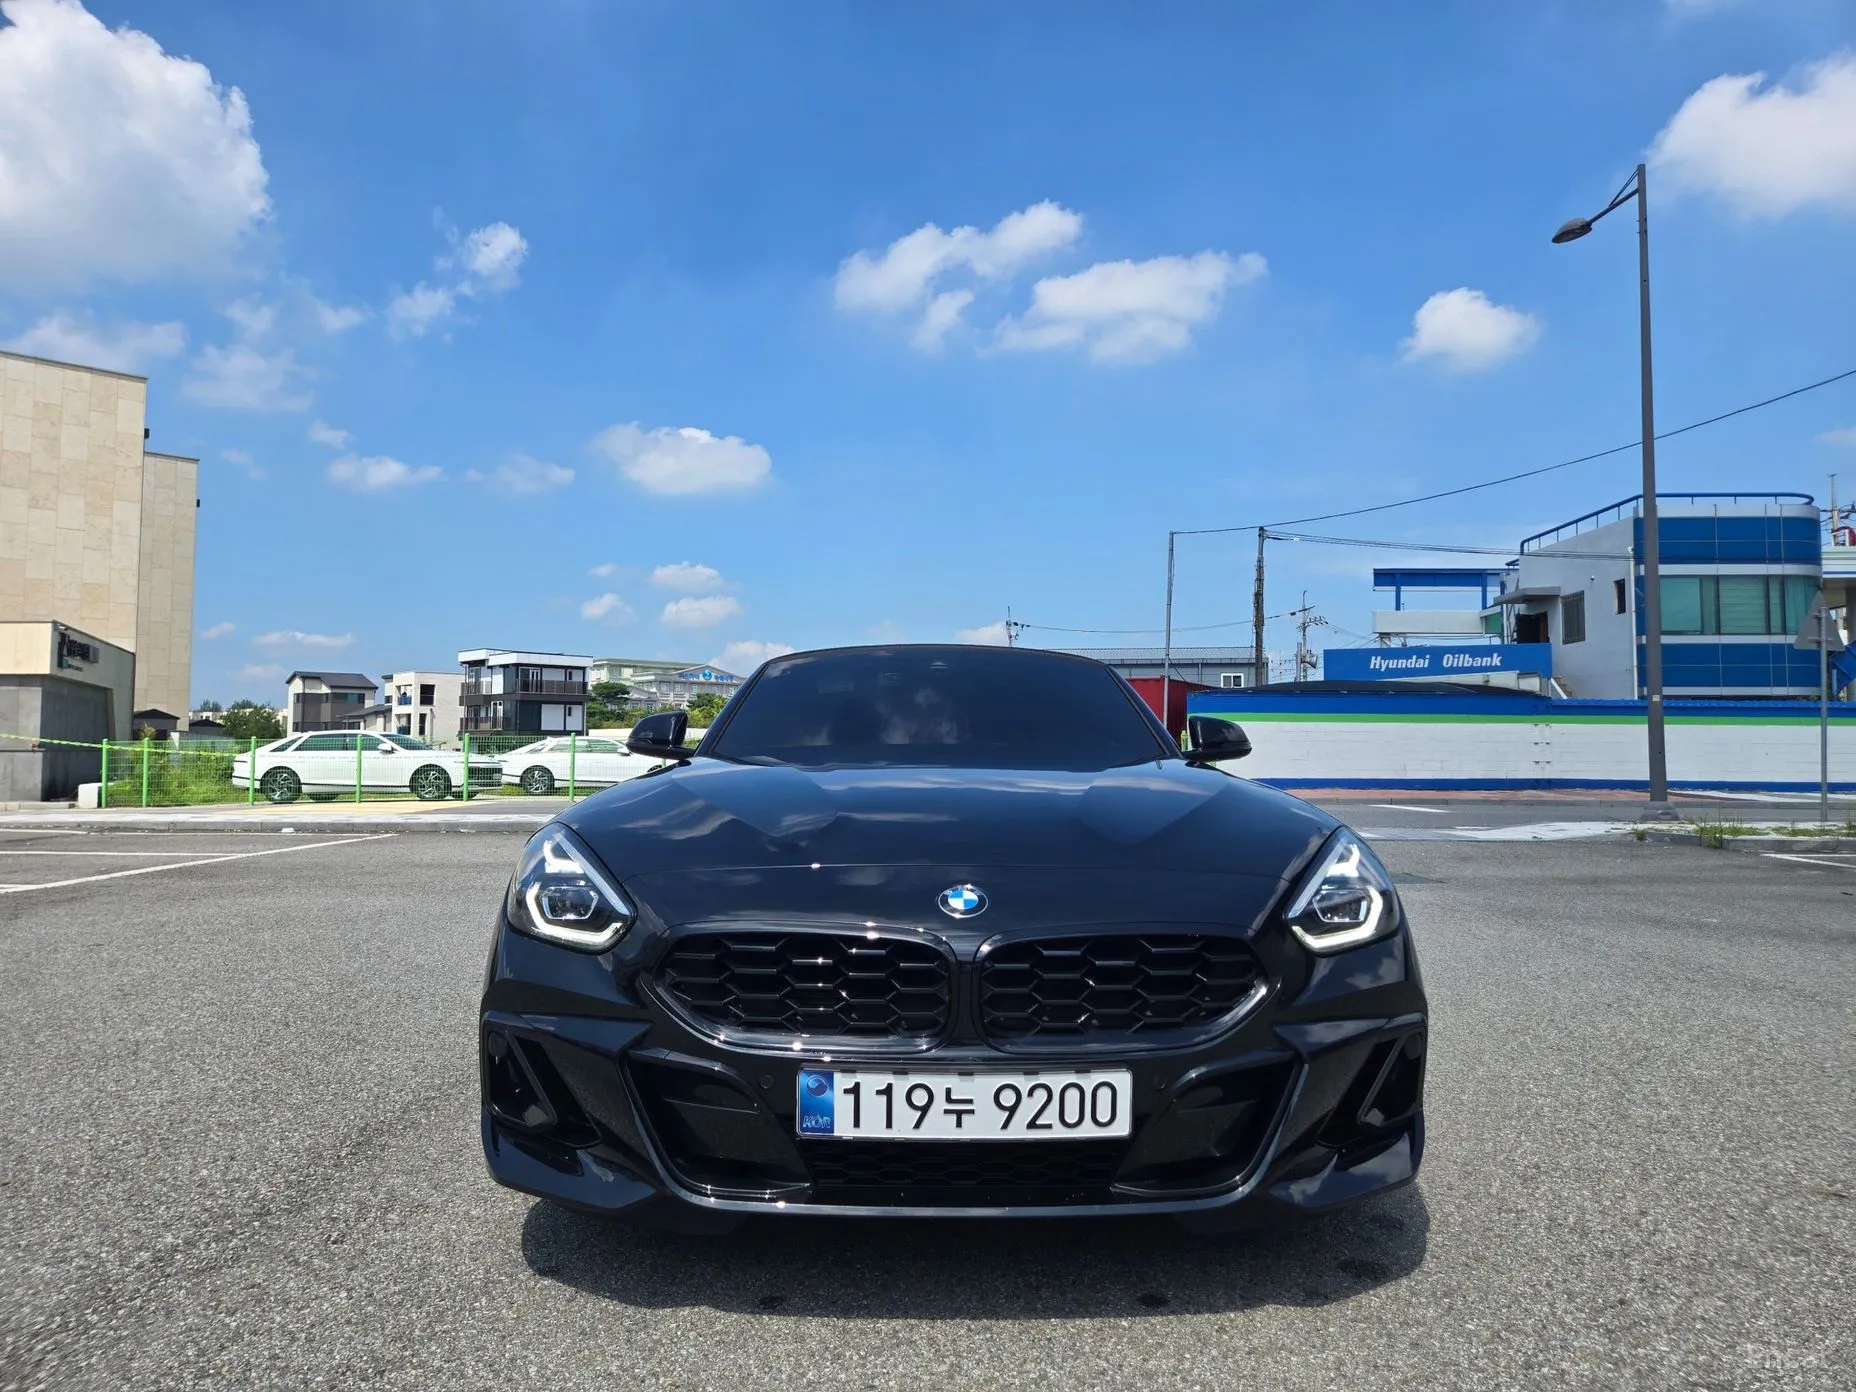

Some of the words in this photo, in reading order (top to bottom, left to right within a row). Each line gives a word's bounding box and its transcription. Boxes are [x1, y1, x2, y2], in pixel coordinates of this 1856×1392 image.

[1370, 655, 1430, 671] Hyundai
[1442, 653, 1502, 668] Oilbank
[843, 1081, 975, 1129] 119누
[993, 1080, 1118, 1130] 9200
[803, 1115, 831, 1129] KOR
